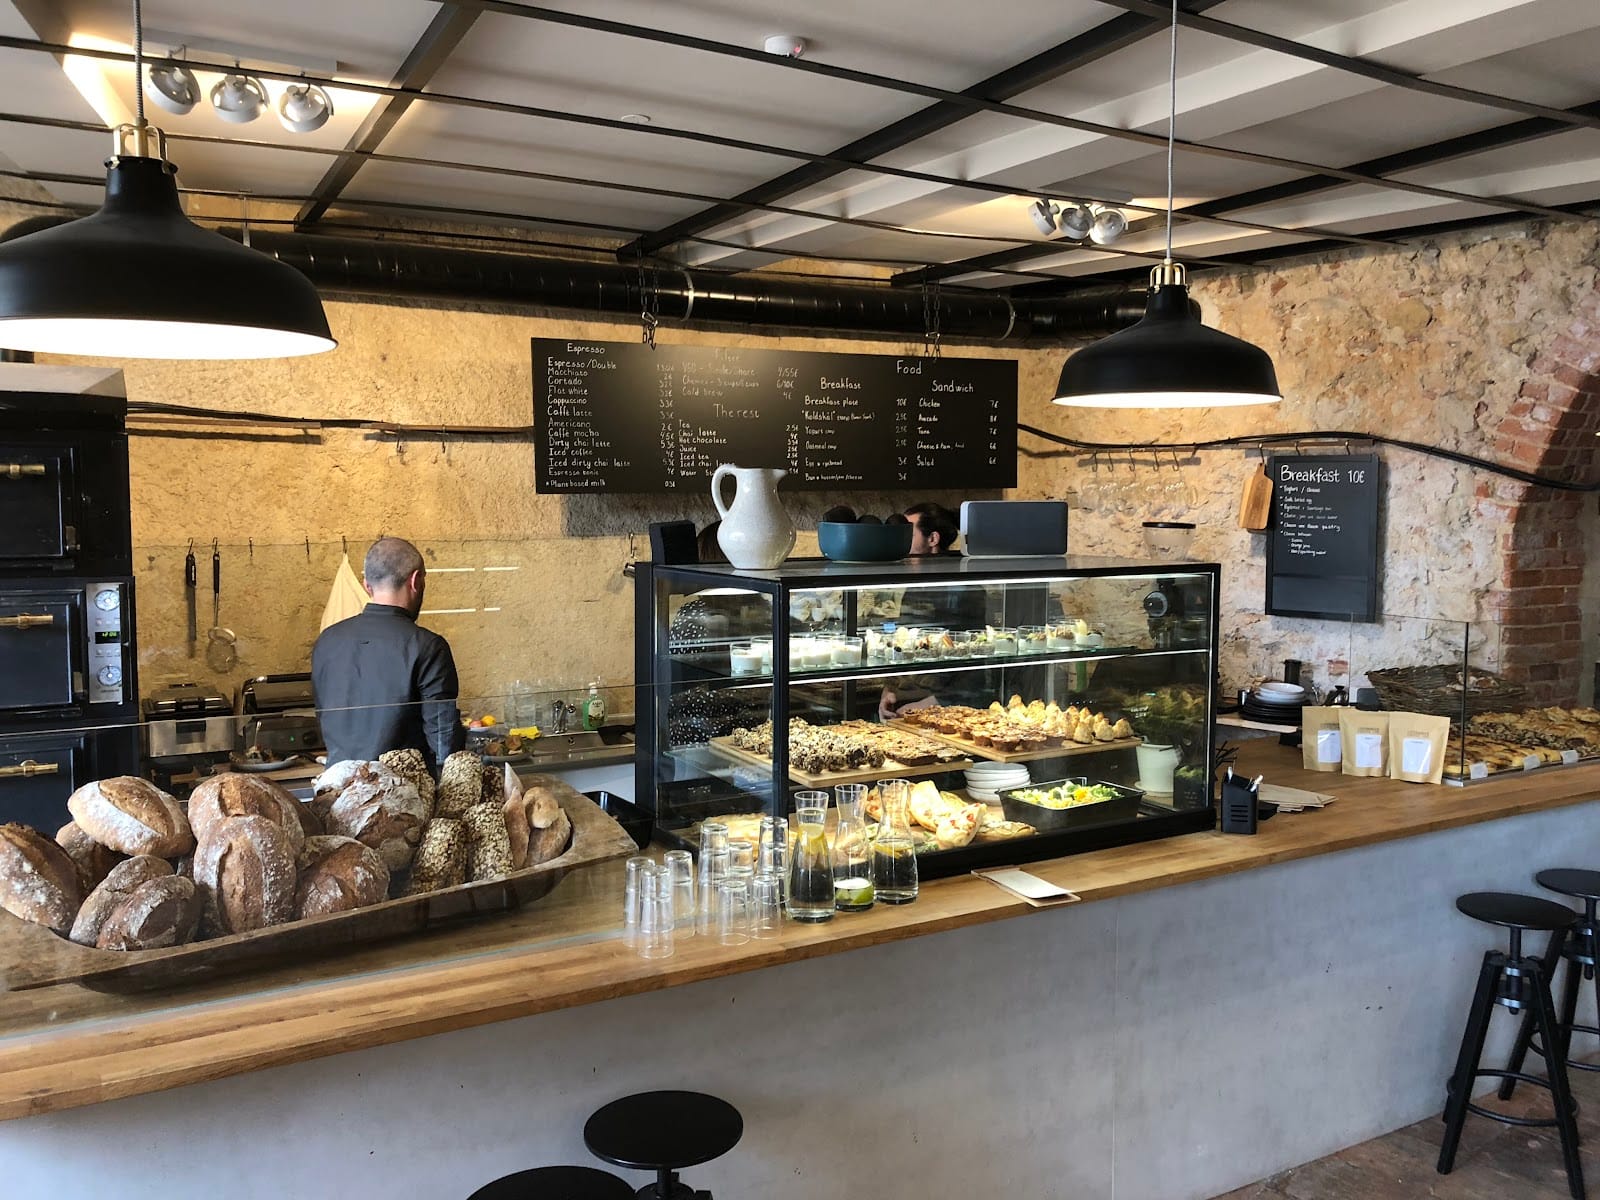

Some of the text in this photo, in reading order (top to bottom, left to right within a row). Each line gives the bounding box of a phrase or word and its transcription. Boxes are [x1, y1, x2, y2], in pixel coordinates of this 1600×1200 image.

[567, 342, 606, 355] Espresso
[896, 359, 922, 374] Food
[547, 367, 589, 377] Macchiato
[547, 376, 583, 386] Cortado
[820, 377, 862, 390] Breakfast
[548, 386, 566, 395] Flat
[568, 386, 589, 396] white
[931, 380, 974, 393] Sandwich
[805, 395, 907, 408] Breakfast plate 10€
[919, 397, 941, 408] Chicken
[573, 407, 593, 417] latte
[713, 403, 734, 418] The
[548, 418, 591, 428] Americano
[679, 419, 691, 428] Tea
[573, 429, 600, 437] mocha
[698, 427, 717, 436] latte
[548, 438, 570, 449] Dirty
[573, 439, 589, 447] chai
[592, 438, 611, 447] latte
[679, 444, 697, 453] Juice
[548, 448, 567, 456] Iced
[570, 448, 593, 456] coffee
[680, 452, 695, 460] Iced
[698, 452, 710, 460] tea
[548, 458, 568, 467] Iced
[571, 458, 591, 469] dirty
[593, 458, 609, 467] chai
[916, 455, 935, 466] Salad
[548, 468, 580, 476] Espresso
[1280, 465, 1365, 484] Breakfast 10€
[569, 480, 589, 488] based
